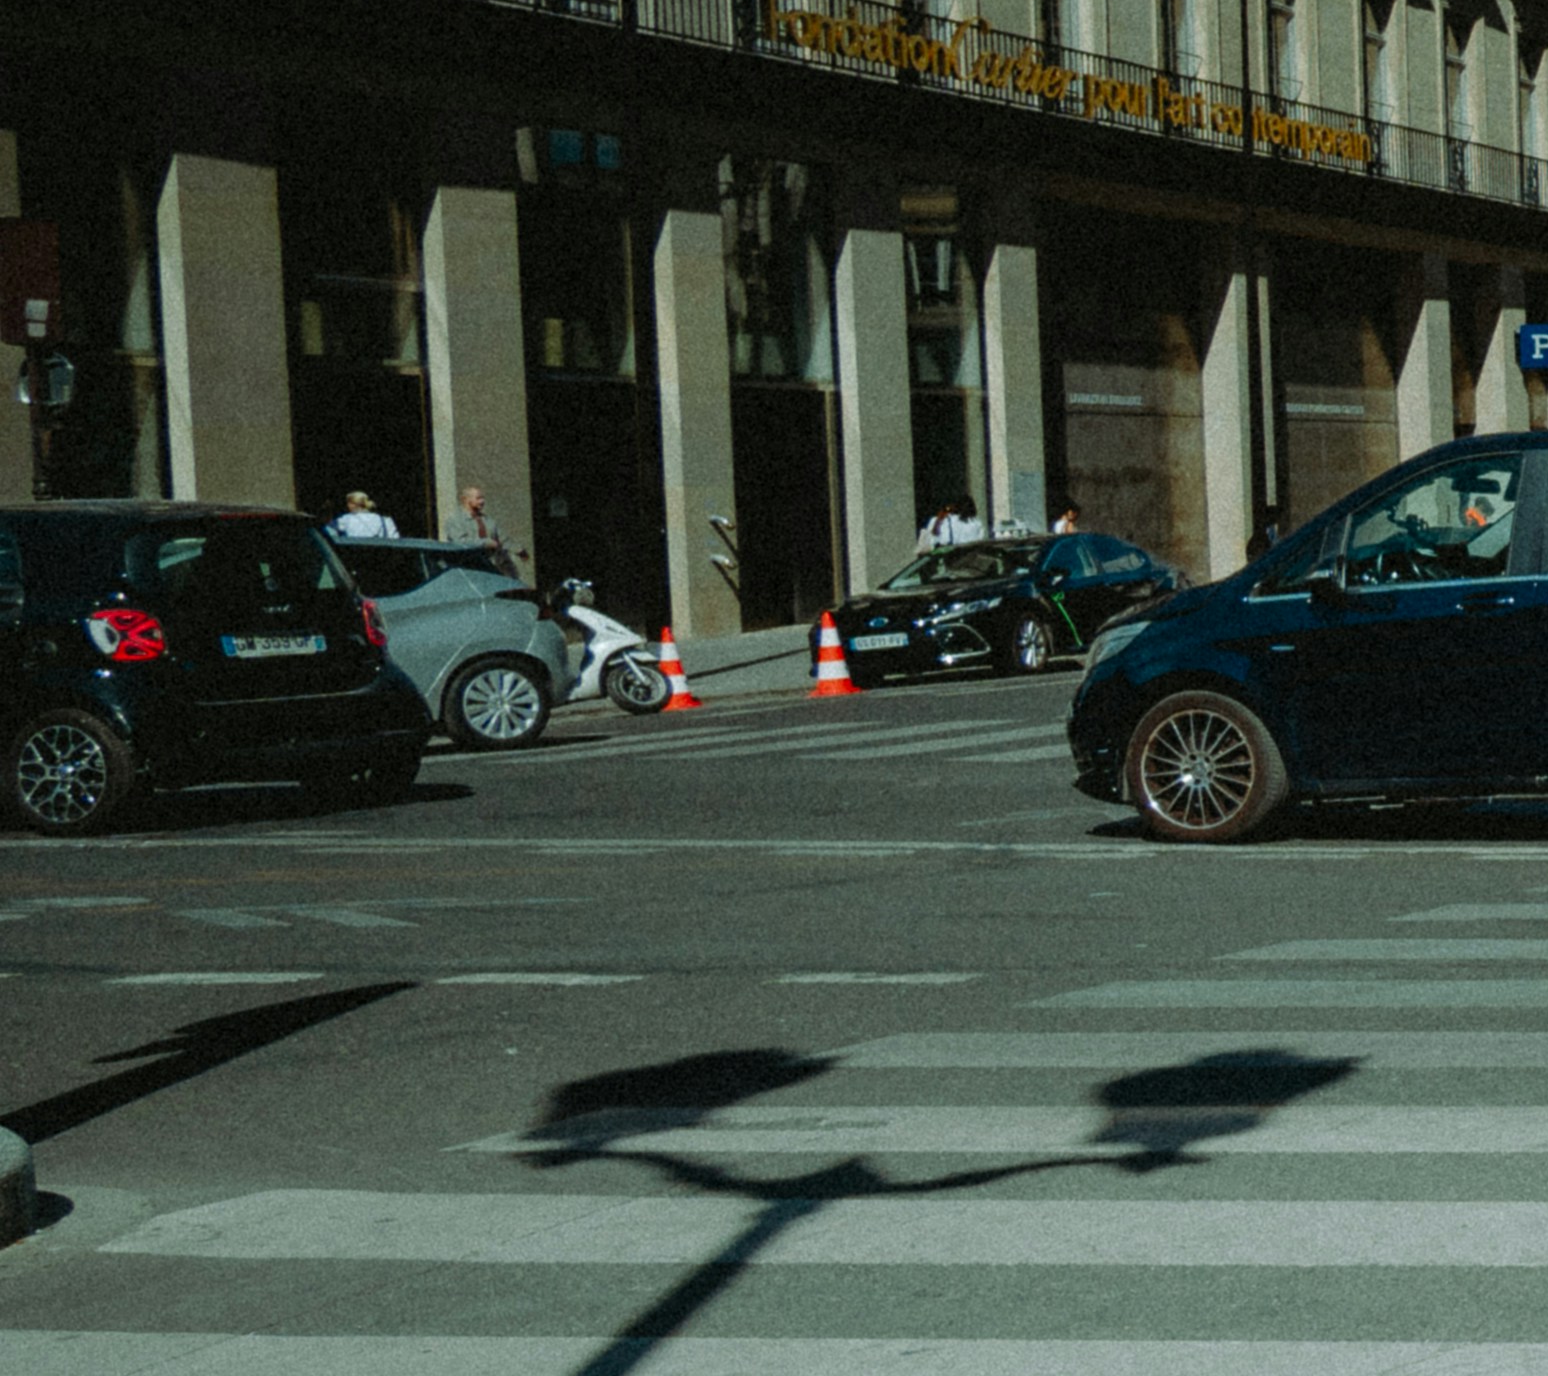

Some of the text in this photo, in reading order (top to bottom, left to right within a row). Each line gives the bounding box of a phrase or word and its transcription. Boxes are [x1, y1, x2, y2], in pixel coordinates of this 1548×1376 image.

[950, 16, 1078, 100] Cartier
[1084, 74, 1148, 119] pour
[1211, 102, 1371, 162] cotemporain
